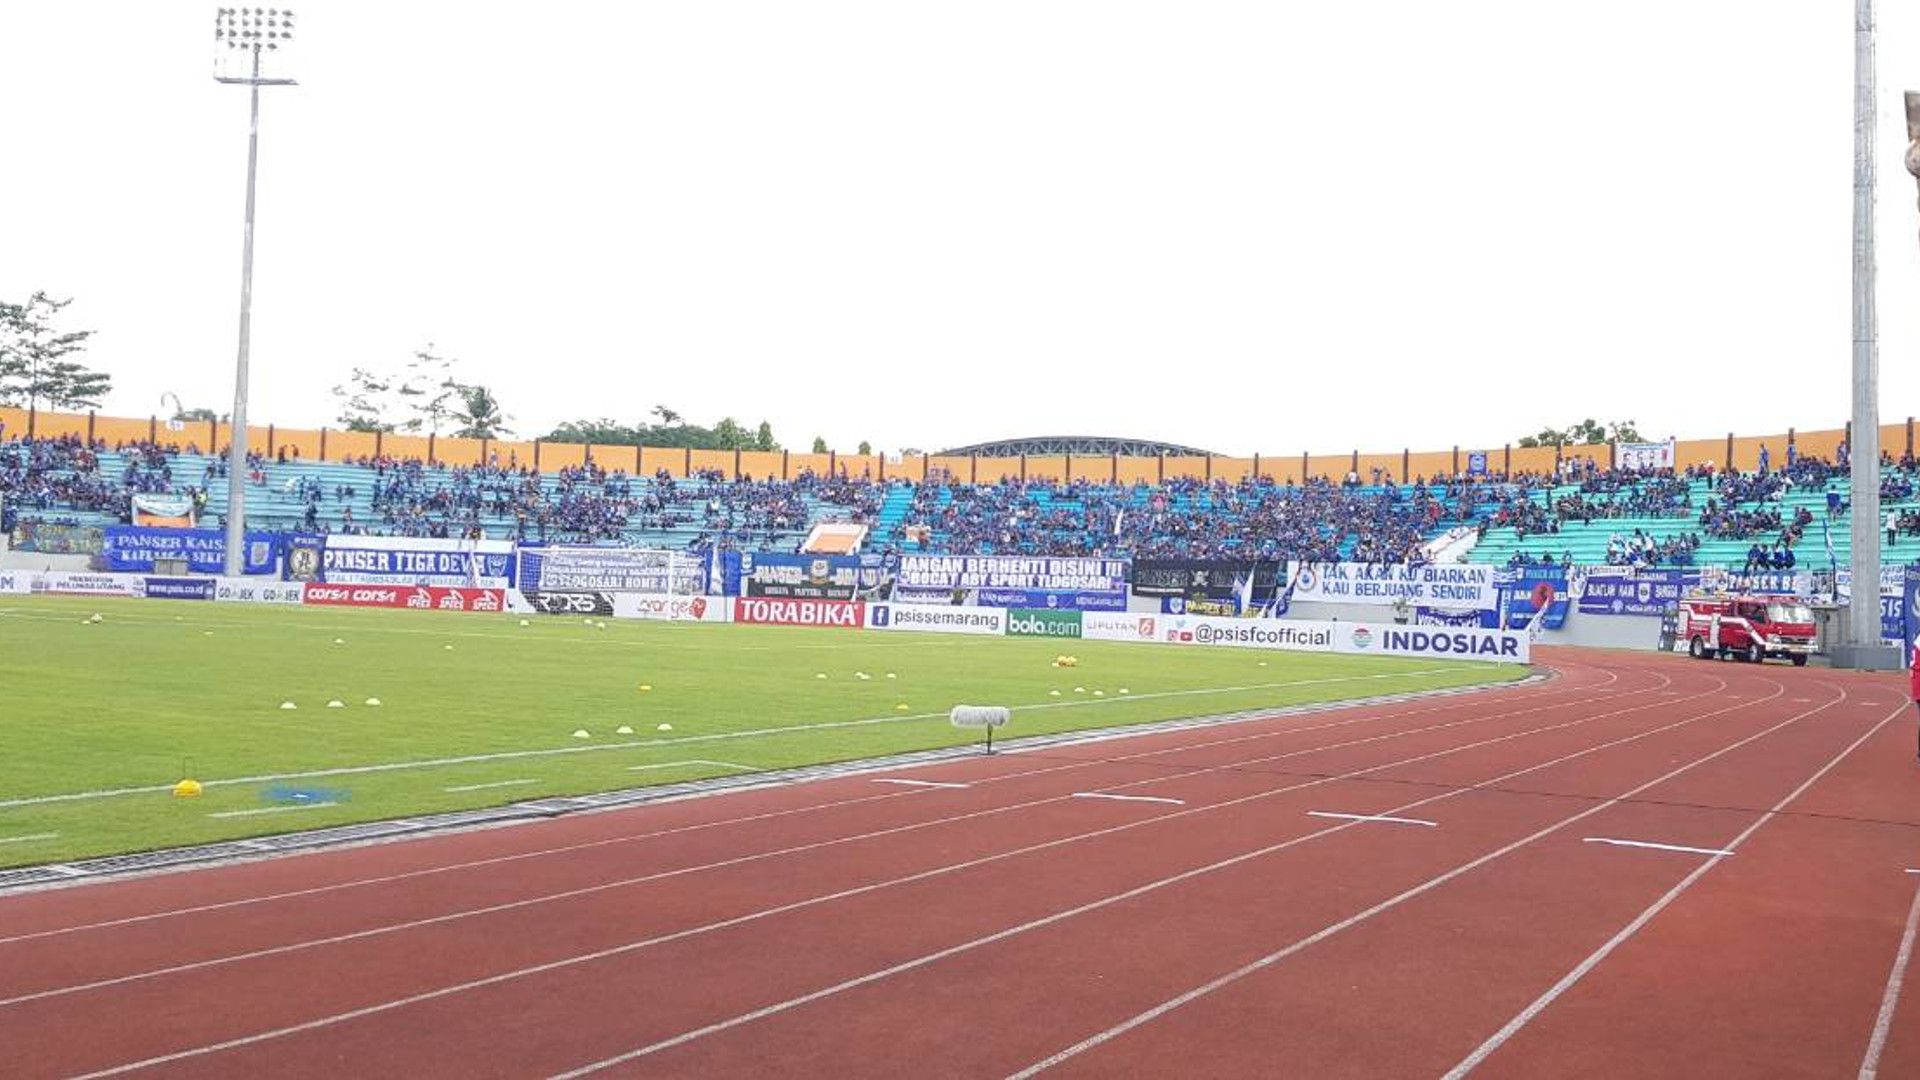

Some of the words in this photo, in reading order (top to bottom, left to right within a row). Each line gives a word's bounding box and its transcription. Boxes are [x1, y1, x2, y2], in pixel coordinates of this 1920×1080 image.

[324, 550, 390, 571] PANSER
[395, 553, 436, 572] TIGA
[966, 558, 1046, 576] BERHENTI
[1049, 559, 1100, 576] DISINI
[990, 574, 1034, 587] SPORT
[1322, 565, 1347, 580] TAK
[1424, 569, 1486, 584] BIARKAN
[1322, 582, 1350, 595] KAU
[1355, 583, 1424, 598] BERJUANG
[1431, 585, 1482, 600] SENDIRI
[740, 600, 856, 625] TORABIKA
[894, 609, 999, 629] psissemarang
[1009, 614, 1079, 635] bola.com
[1196, 625, 1330, 646] @psisfcofficial
[1383, 630, 1518, 657] INDOSIAR
